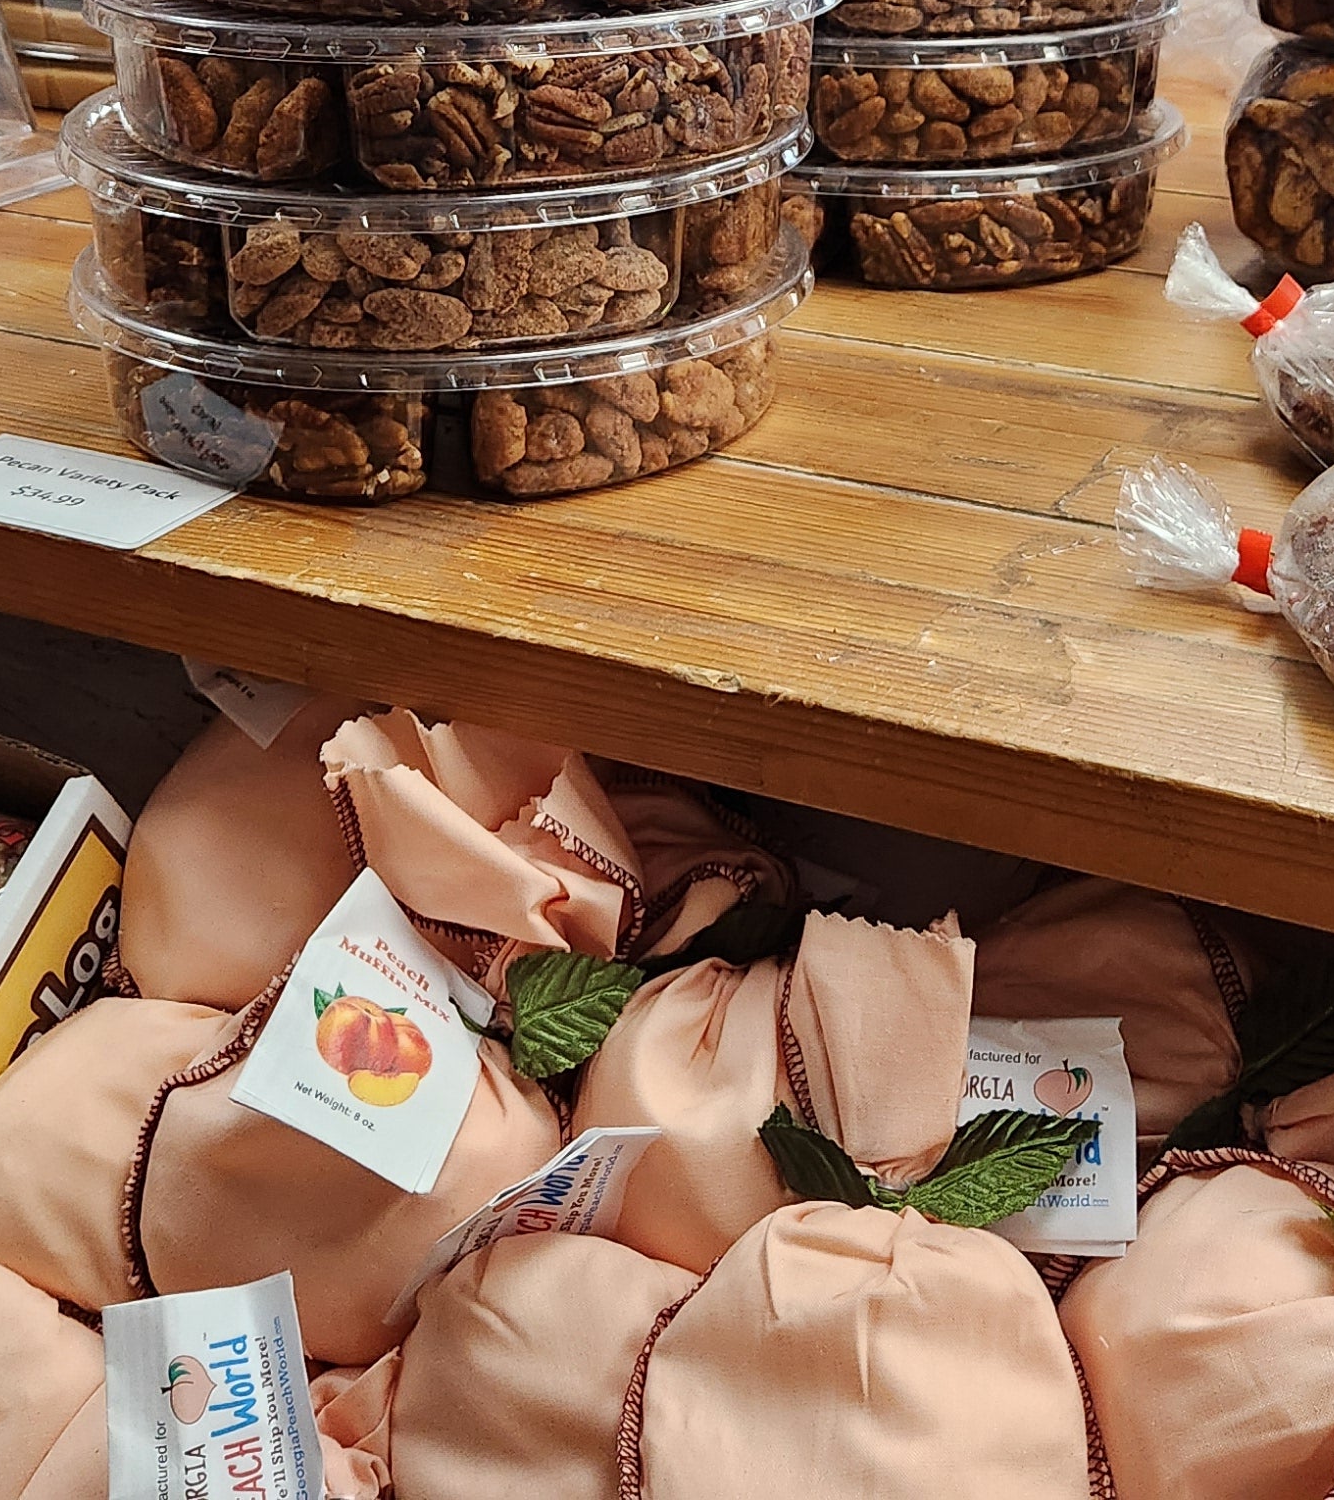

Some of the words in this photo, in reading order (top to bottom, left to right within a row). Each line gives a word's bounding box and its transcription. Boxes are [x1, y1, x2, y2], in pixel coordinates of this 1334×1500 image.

[9, 484, 86, 507] $34.99
[56, 466, 130, 491] Variety
[129, 482, 183, 502] Pack
[338, 935, 408, 993] Muffin
[412, 992, 452, 1024] Mix
[374, 936, 431, 993] Peach
[969, 1049, 1021, 1064] factured
[1025, 1052, 1042, 1065] for
[294, 1080, 313, 1097] Net
[314, 1089, 352, 1117] Weight:
[353, 1112, 361, 1122] 8
[362, 1118, 376, 1132] oz.
[963, 1075, 1015, 1102] RGIA
[560, 1207, 581, 1231] Ship
[571, 1189, 588, 1209] You
[585, 1156, 605, 1189] More!
[1050, 1173, 1097, 1188] More!
[254, 1334, 274, 1388] More!
[209, 1334, 259, 1438] World
[266, 1390, 279, 1426] You
[155, 1421, 167, 1440] for
[270, 1426, 285, 1465] Ship
[184, 1443, 209, 1500] RGIA
[273, 1468, 289, 1500] e'll
